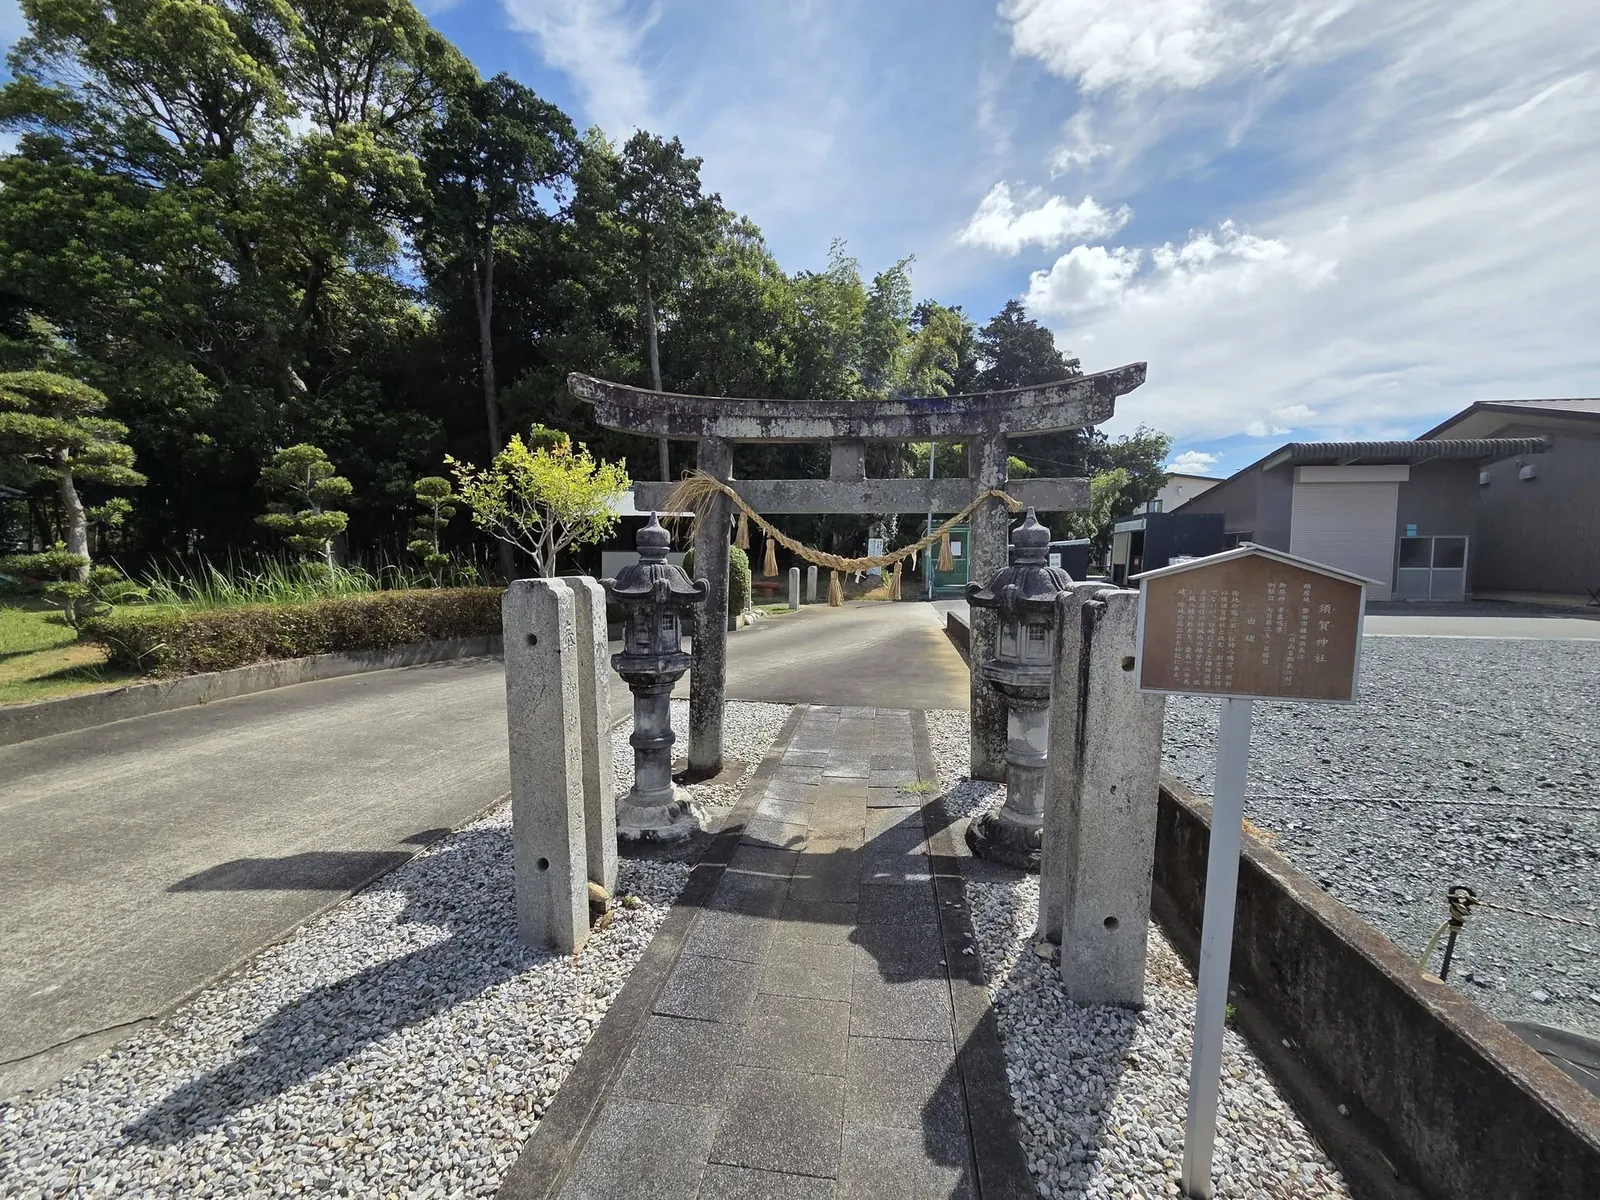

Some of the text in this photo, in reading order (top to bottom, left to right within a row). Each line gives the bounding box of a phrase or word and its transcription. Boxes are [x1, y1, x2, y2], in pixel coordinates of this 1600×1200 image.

[1244, 616, 1256, 643] 由緒
[1314, 603, 1332, 663] 須賀神社
